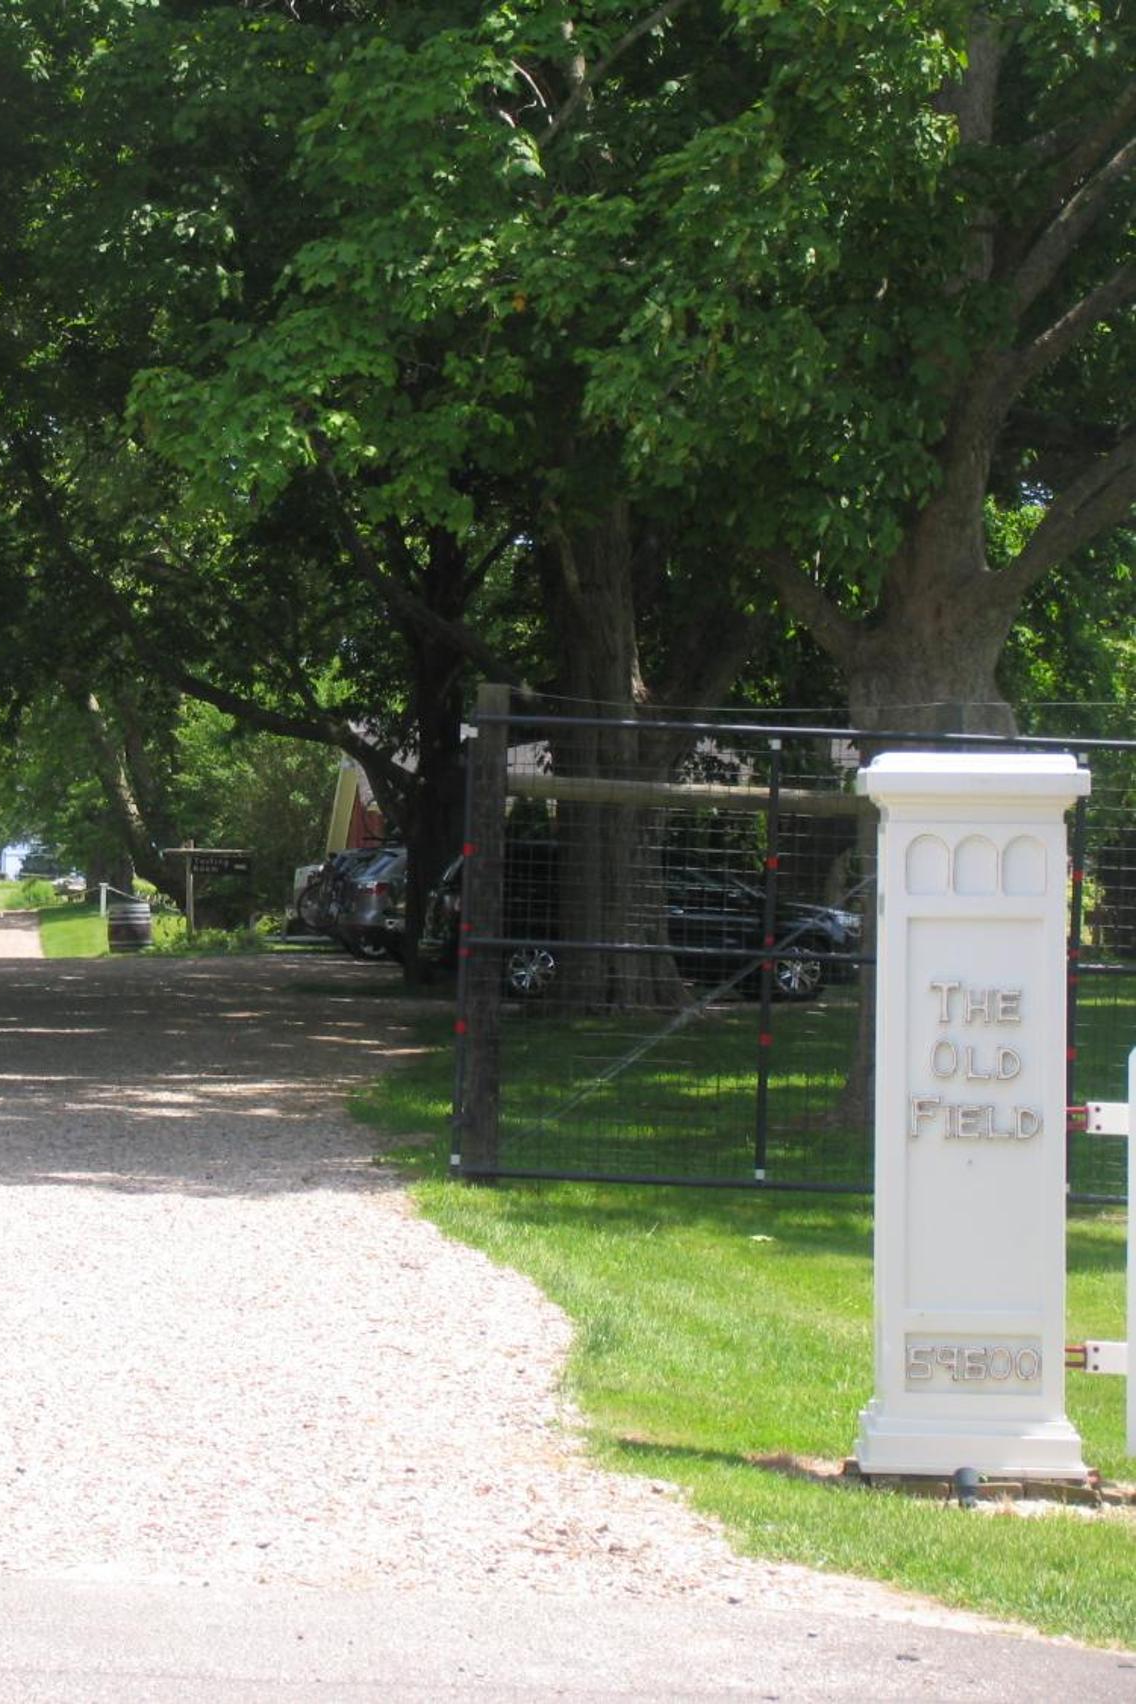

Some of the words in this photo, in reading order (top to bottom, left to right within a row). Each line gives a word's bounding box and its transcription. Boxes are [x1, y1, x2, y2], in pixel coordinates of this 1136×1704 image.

[929, 981, 1022, 1025] THE
[930, 1040, 1022, 1081] OLD
[909, 1095, 1043, 1140] FIELD
